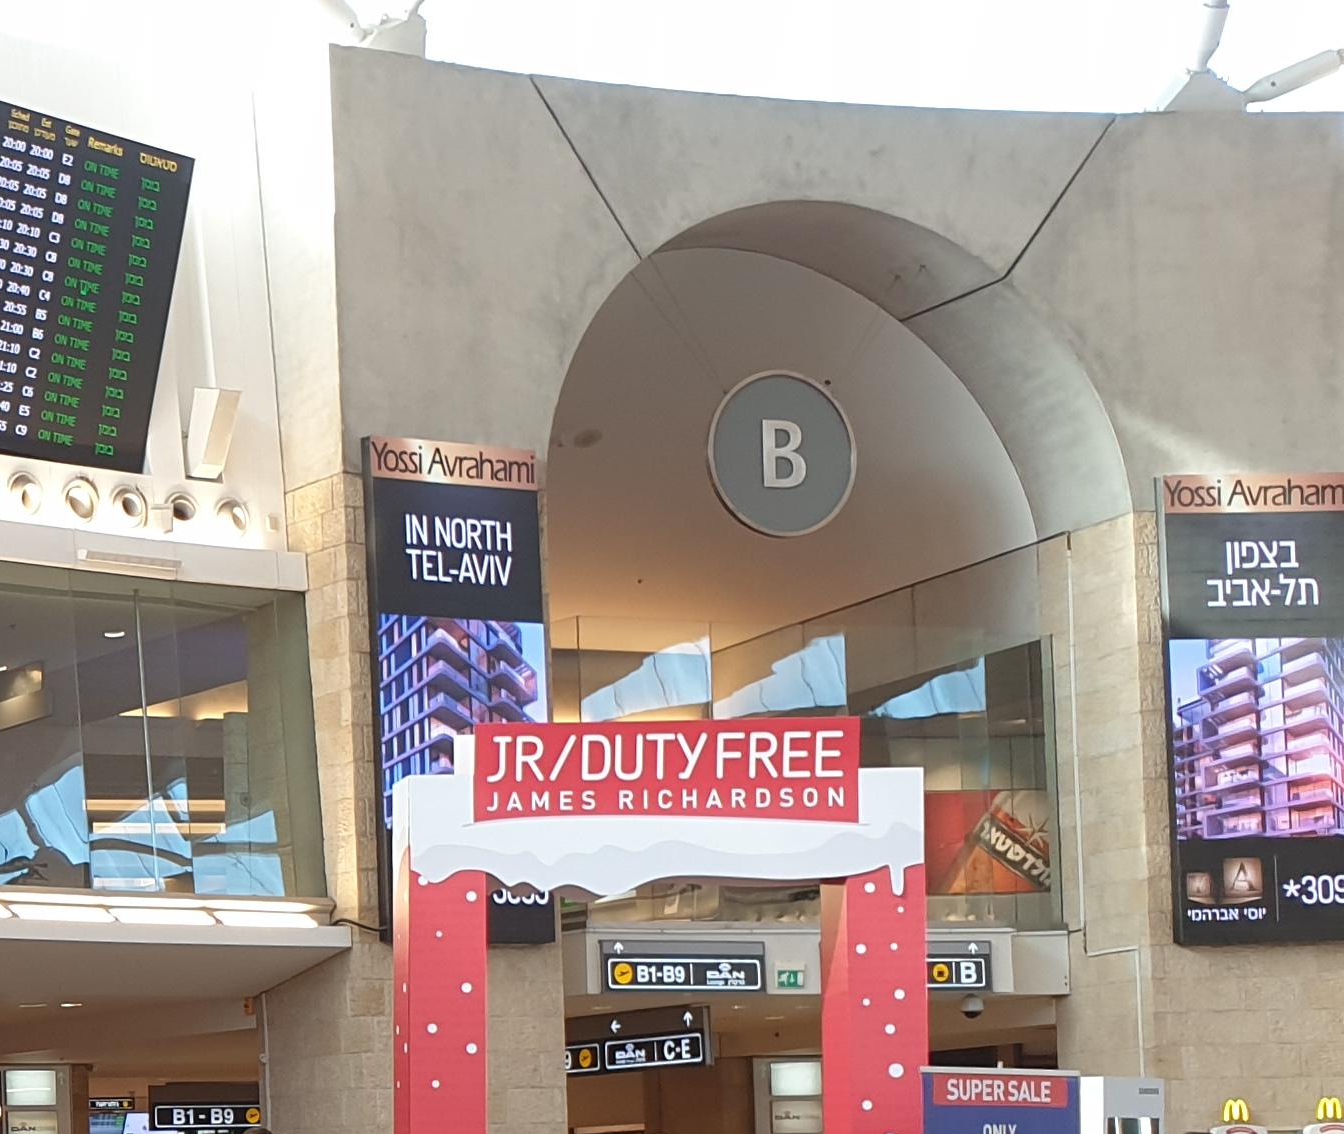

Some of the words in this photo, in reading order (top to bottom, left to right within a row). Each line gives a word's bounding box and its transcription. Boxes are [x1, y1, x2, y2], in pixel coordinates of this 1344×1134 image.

[38, 430, 50, 441] ON
[53, 433, 74, 446] TIME
[372, 441, 422, 474] Yossi
[428, 447, 535, 484] Avrahami
[761, 419, 807, 487] B
[1164, 479, 1222, 507] Yossi
[405, 514, 428, 546] IN
[435, 516, 512, 552] NORTH
[406, 549, 512, 586] TEL-AVIV
[1226, 540, 1299, 575] בצפון
[1207, 573, 1319, 607] תל-אביב
[487, 790, 596, 812] JAMES
[618, 787, 844, 809] RICHARDSON
[980, 821, 1050, 887] ולדסטאר
[1188, 909, 1239, 921] אברהמי
[1244, 907, 1266, 919] יוסי
[637, 965, 685, 983] B1-B9
[960, 962, 978, 984] B
[947, 1079, 1005, 1101] SUPER
[1008, 1081, 1051, 1103] SALE
[173, 1109, 193, 1125] B1
[211, 1109, 234, 1124] B9
